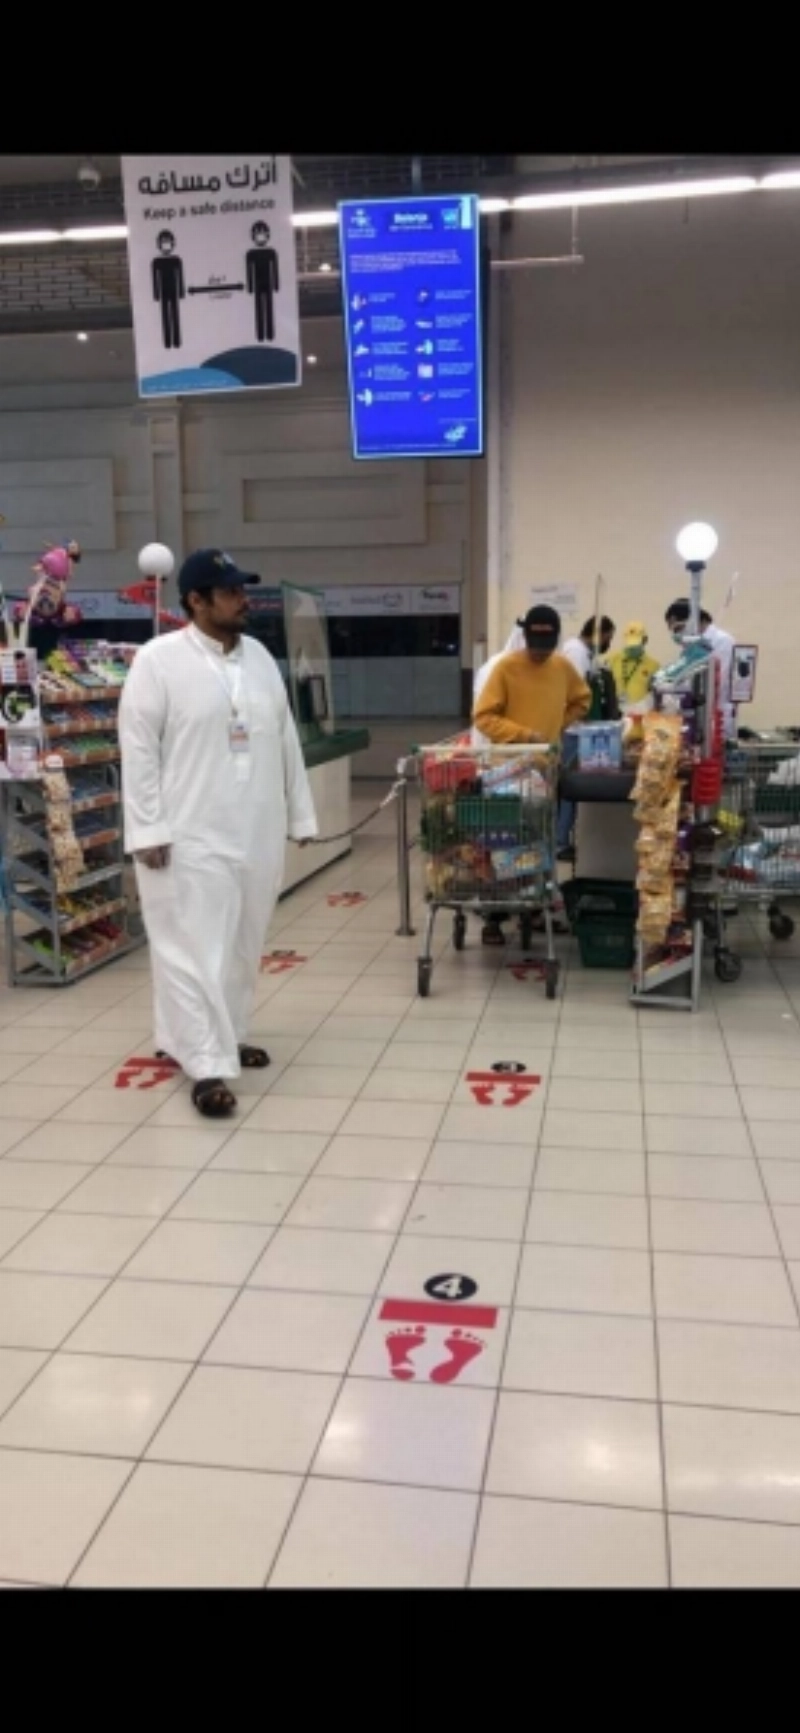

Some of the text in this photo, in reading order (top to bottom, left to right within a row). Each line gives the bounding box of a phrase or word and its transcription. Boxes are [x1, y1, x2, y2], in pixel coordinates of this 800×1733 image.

[143, 207, 177, 221] Keep
[190, 201, 217, 216] safe
[220, 198, 275, 214] distance
